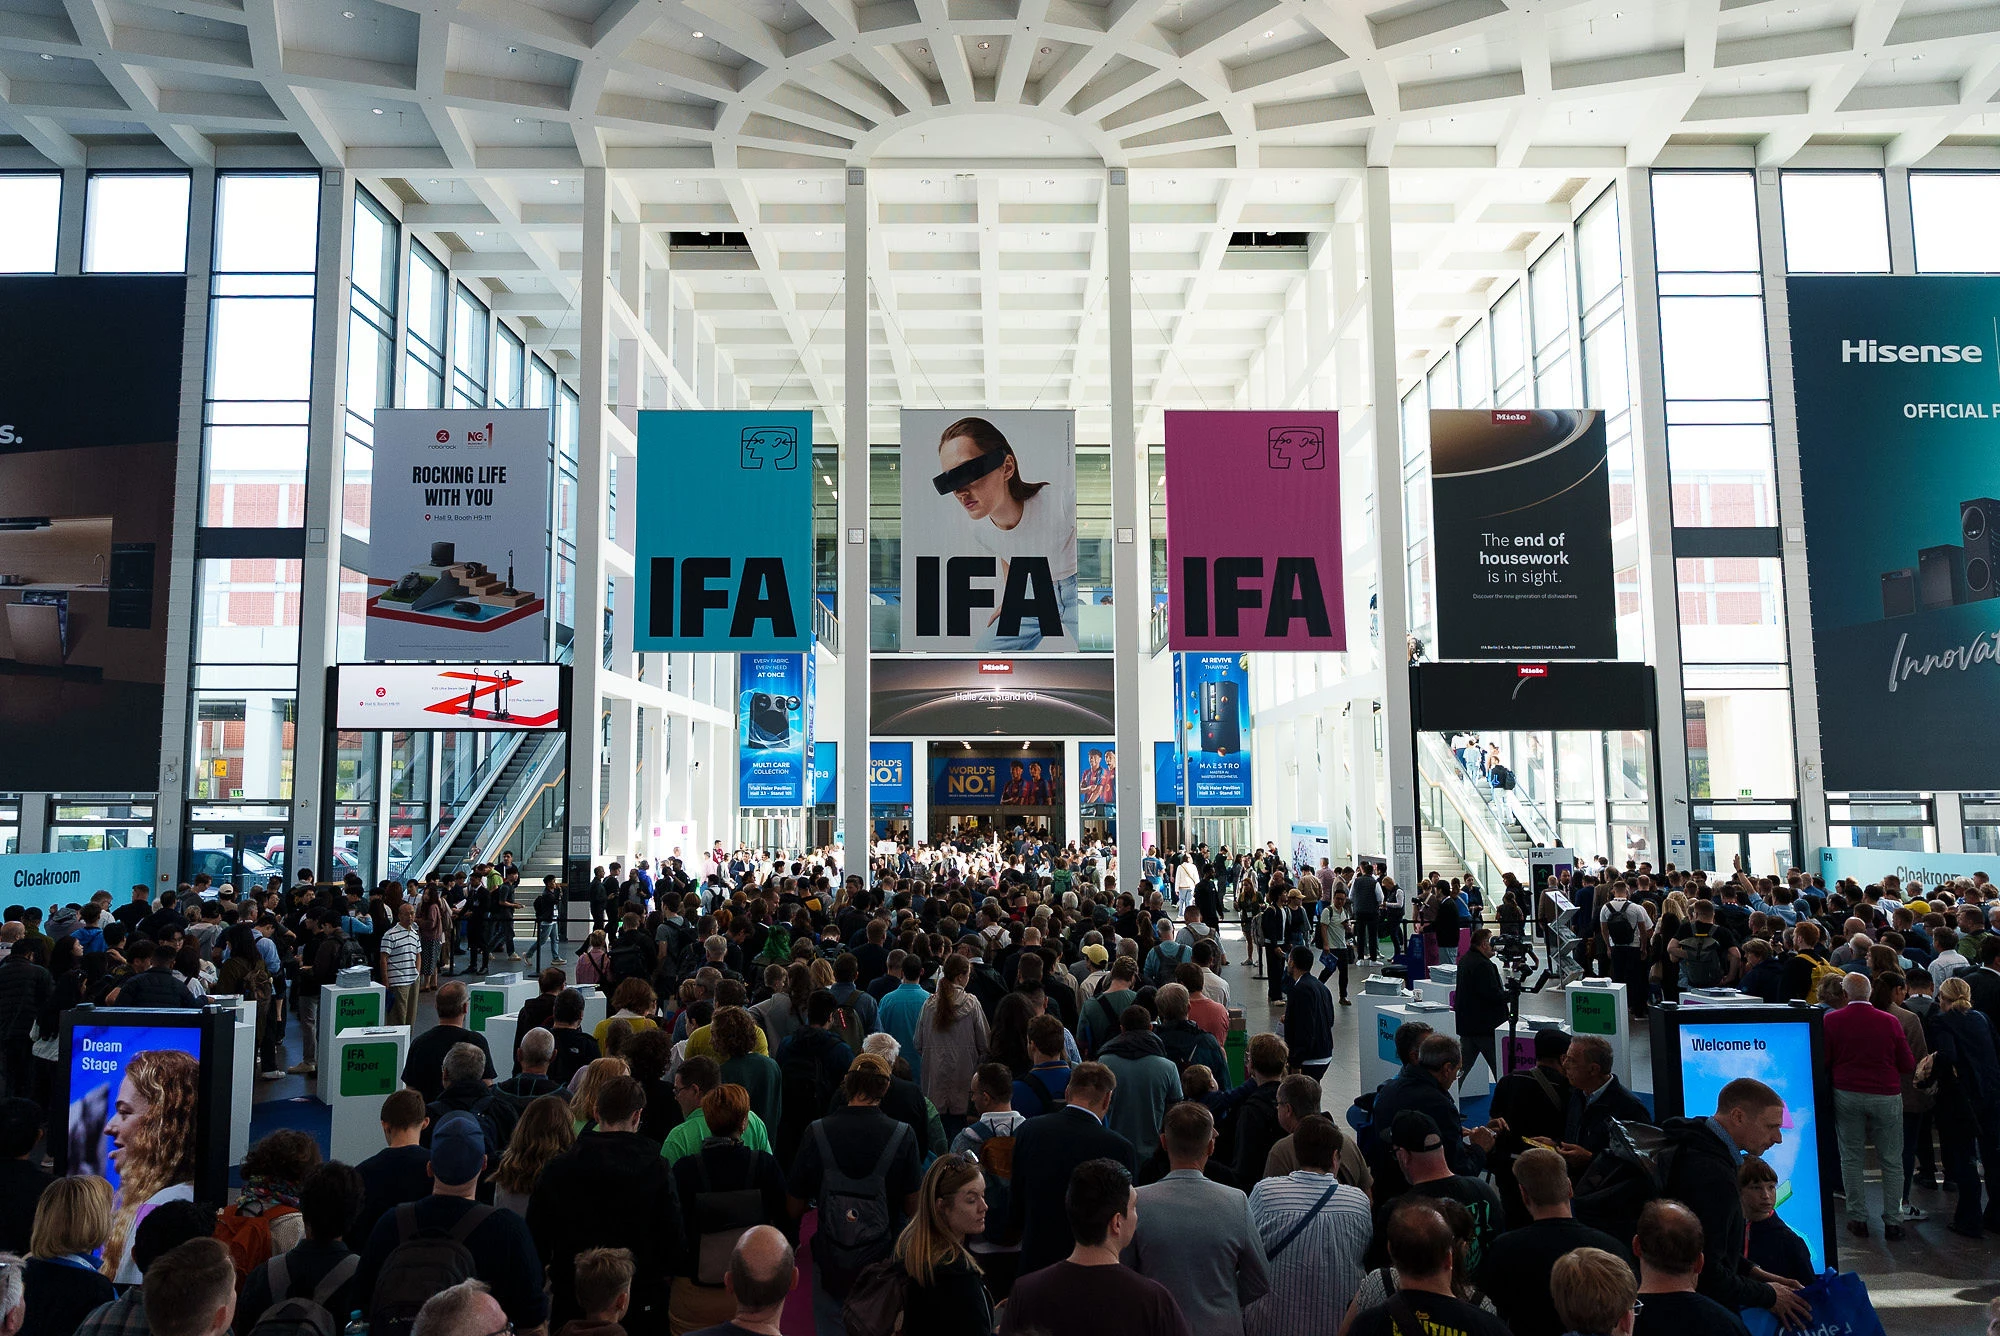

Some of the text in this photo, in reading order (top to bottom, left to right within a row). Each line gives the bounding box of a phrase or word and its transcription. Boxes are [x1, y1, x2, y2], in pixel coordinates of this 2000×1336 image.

[1842, 339, 1982, 363] Hisense
[1496, 413, 1527, 421] Miele
[1903, 403, 1989, 419] OFFICIAL
[412, 466, 507, 484] ROCKING LIFE
[424, 488, 493, 506] WITH YOU
[1481, 533, 1566, 547] The end of
[1479, 551, 1570, 566] housework
[1488, 570, 1562, 587] is in sight.
[648, 557, 798, 638] IFA
[916, 556, 1063, 638] IFA
[1182, 556, 1334, 638] IFA
[955, 692, 977, 701] Halle
[995, 692, 1020, 701] Stand
[1023, 692, 1038, 701] 101
[815, 770, 829, 779] ea
[949, 766, 995, 775] WORLD'S
[948, 775, 995, 793] NO.1
[1823, 852, 1833, 862] IFA
[13, 868, 80, 888] Cloakroom
[340, 998, 355, 1007] IFA
[473, 994, 484, 1003] IFA
[1575, 996, 1590, 1005] IFA
[340, 1007, 365, 1017] Paper
[473, 1003, 493, 1013] Paper
[1576, 1005, 1601, 1016] Paper
[82, 1039, 123, 1053] Dream
[1691, 1038, 1767, 1051] Welcome to
[347, 1048, 365, 1060] IFA
[82, 1056, 118, 1074] Stage
[347, 1061, 380, 1073] Paper
